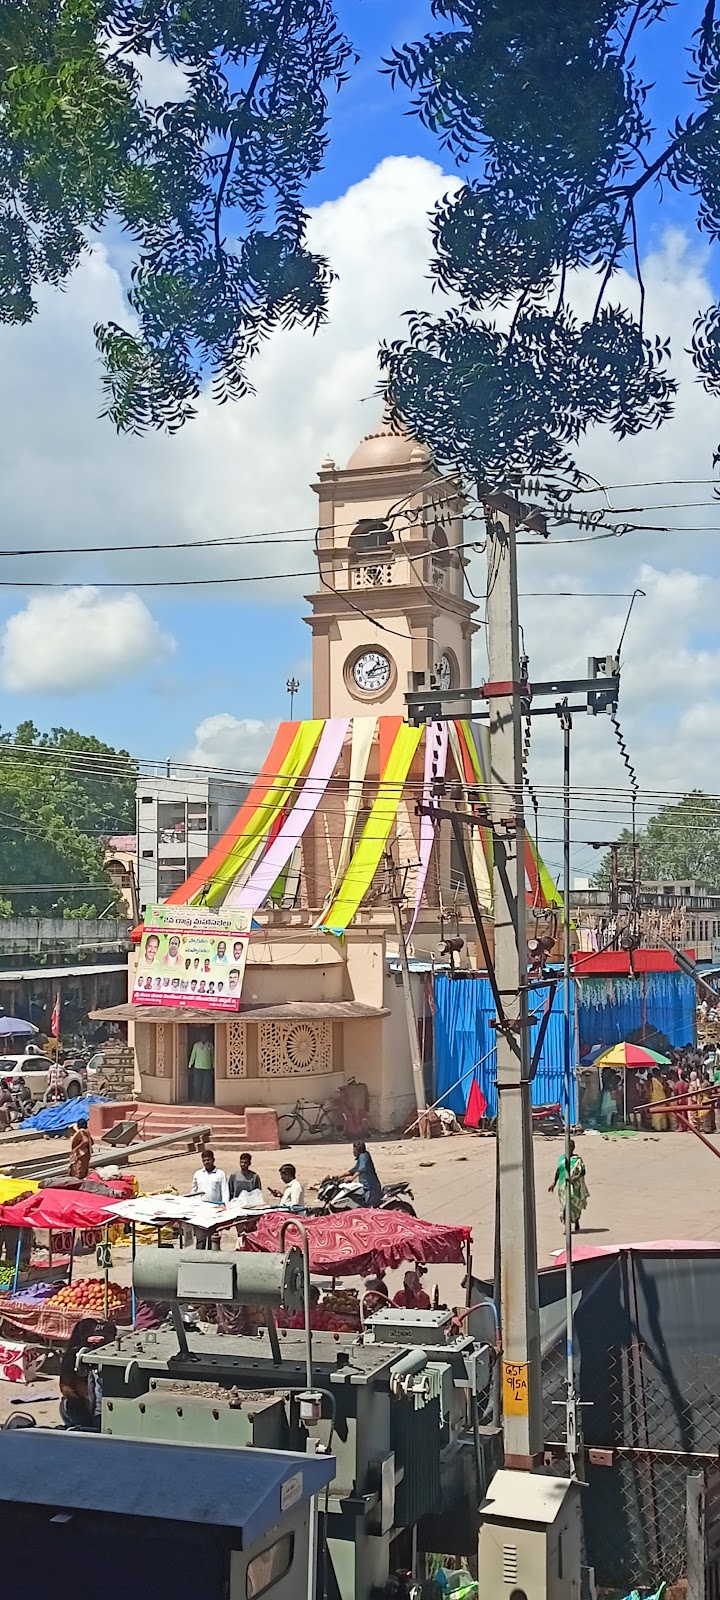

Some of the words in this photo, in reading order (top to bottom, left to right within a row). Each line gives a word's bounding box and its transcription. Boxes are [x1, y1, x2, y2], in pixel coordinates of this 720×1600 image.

[97, 1246, 112, 1268] 30
[505, 1365, 523, 1376] GSF
[514, 1391, 523, 1401] L
